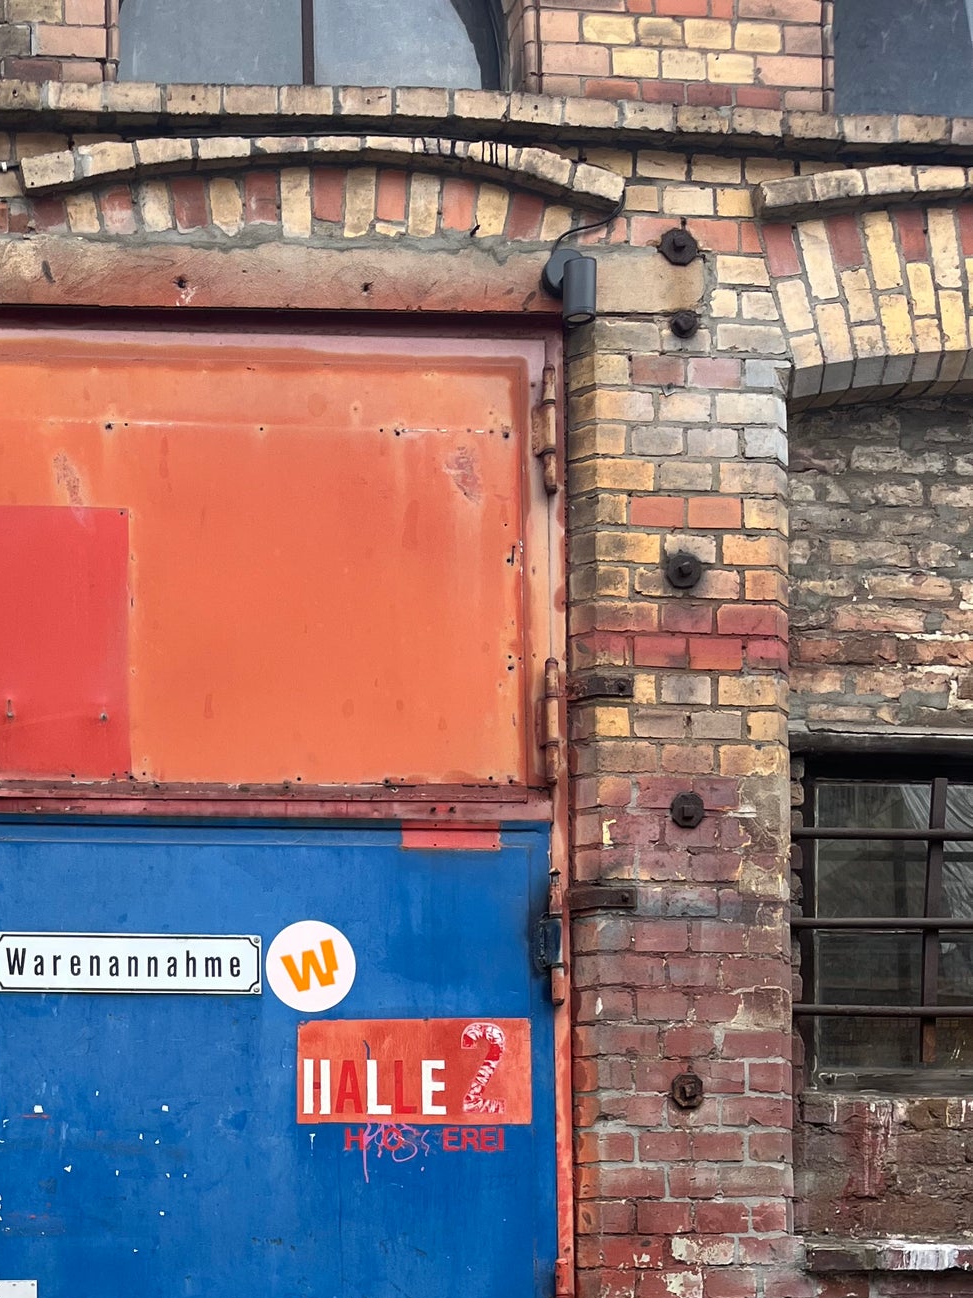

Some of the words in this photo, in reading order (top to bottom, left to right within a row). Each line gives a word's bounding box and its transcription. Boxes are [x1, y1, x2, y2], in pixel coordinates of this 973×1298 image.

[5, 947, 242, 979] Warenannahme
[280, 938, 340, 993] W
[302, 1059, 447, 1115] HALLE
[460, 1022, 507, 1114] 2
